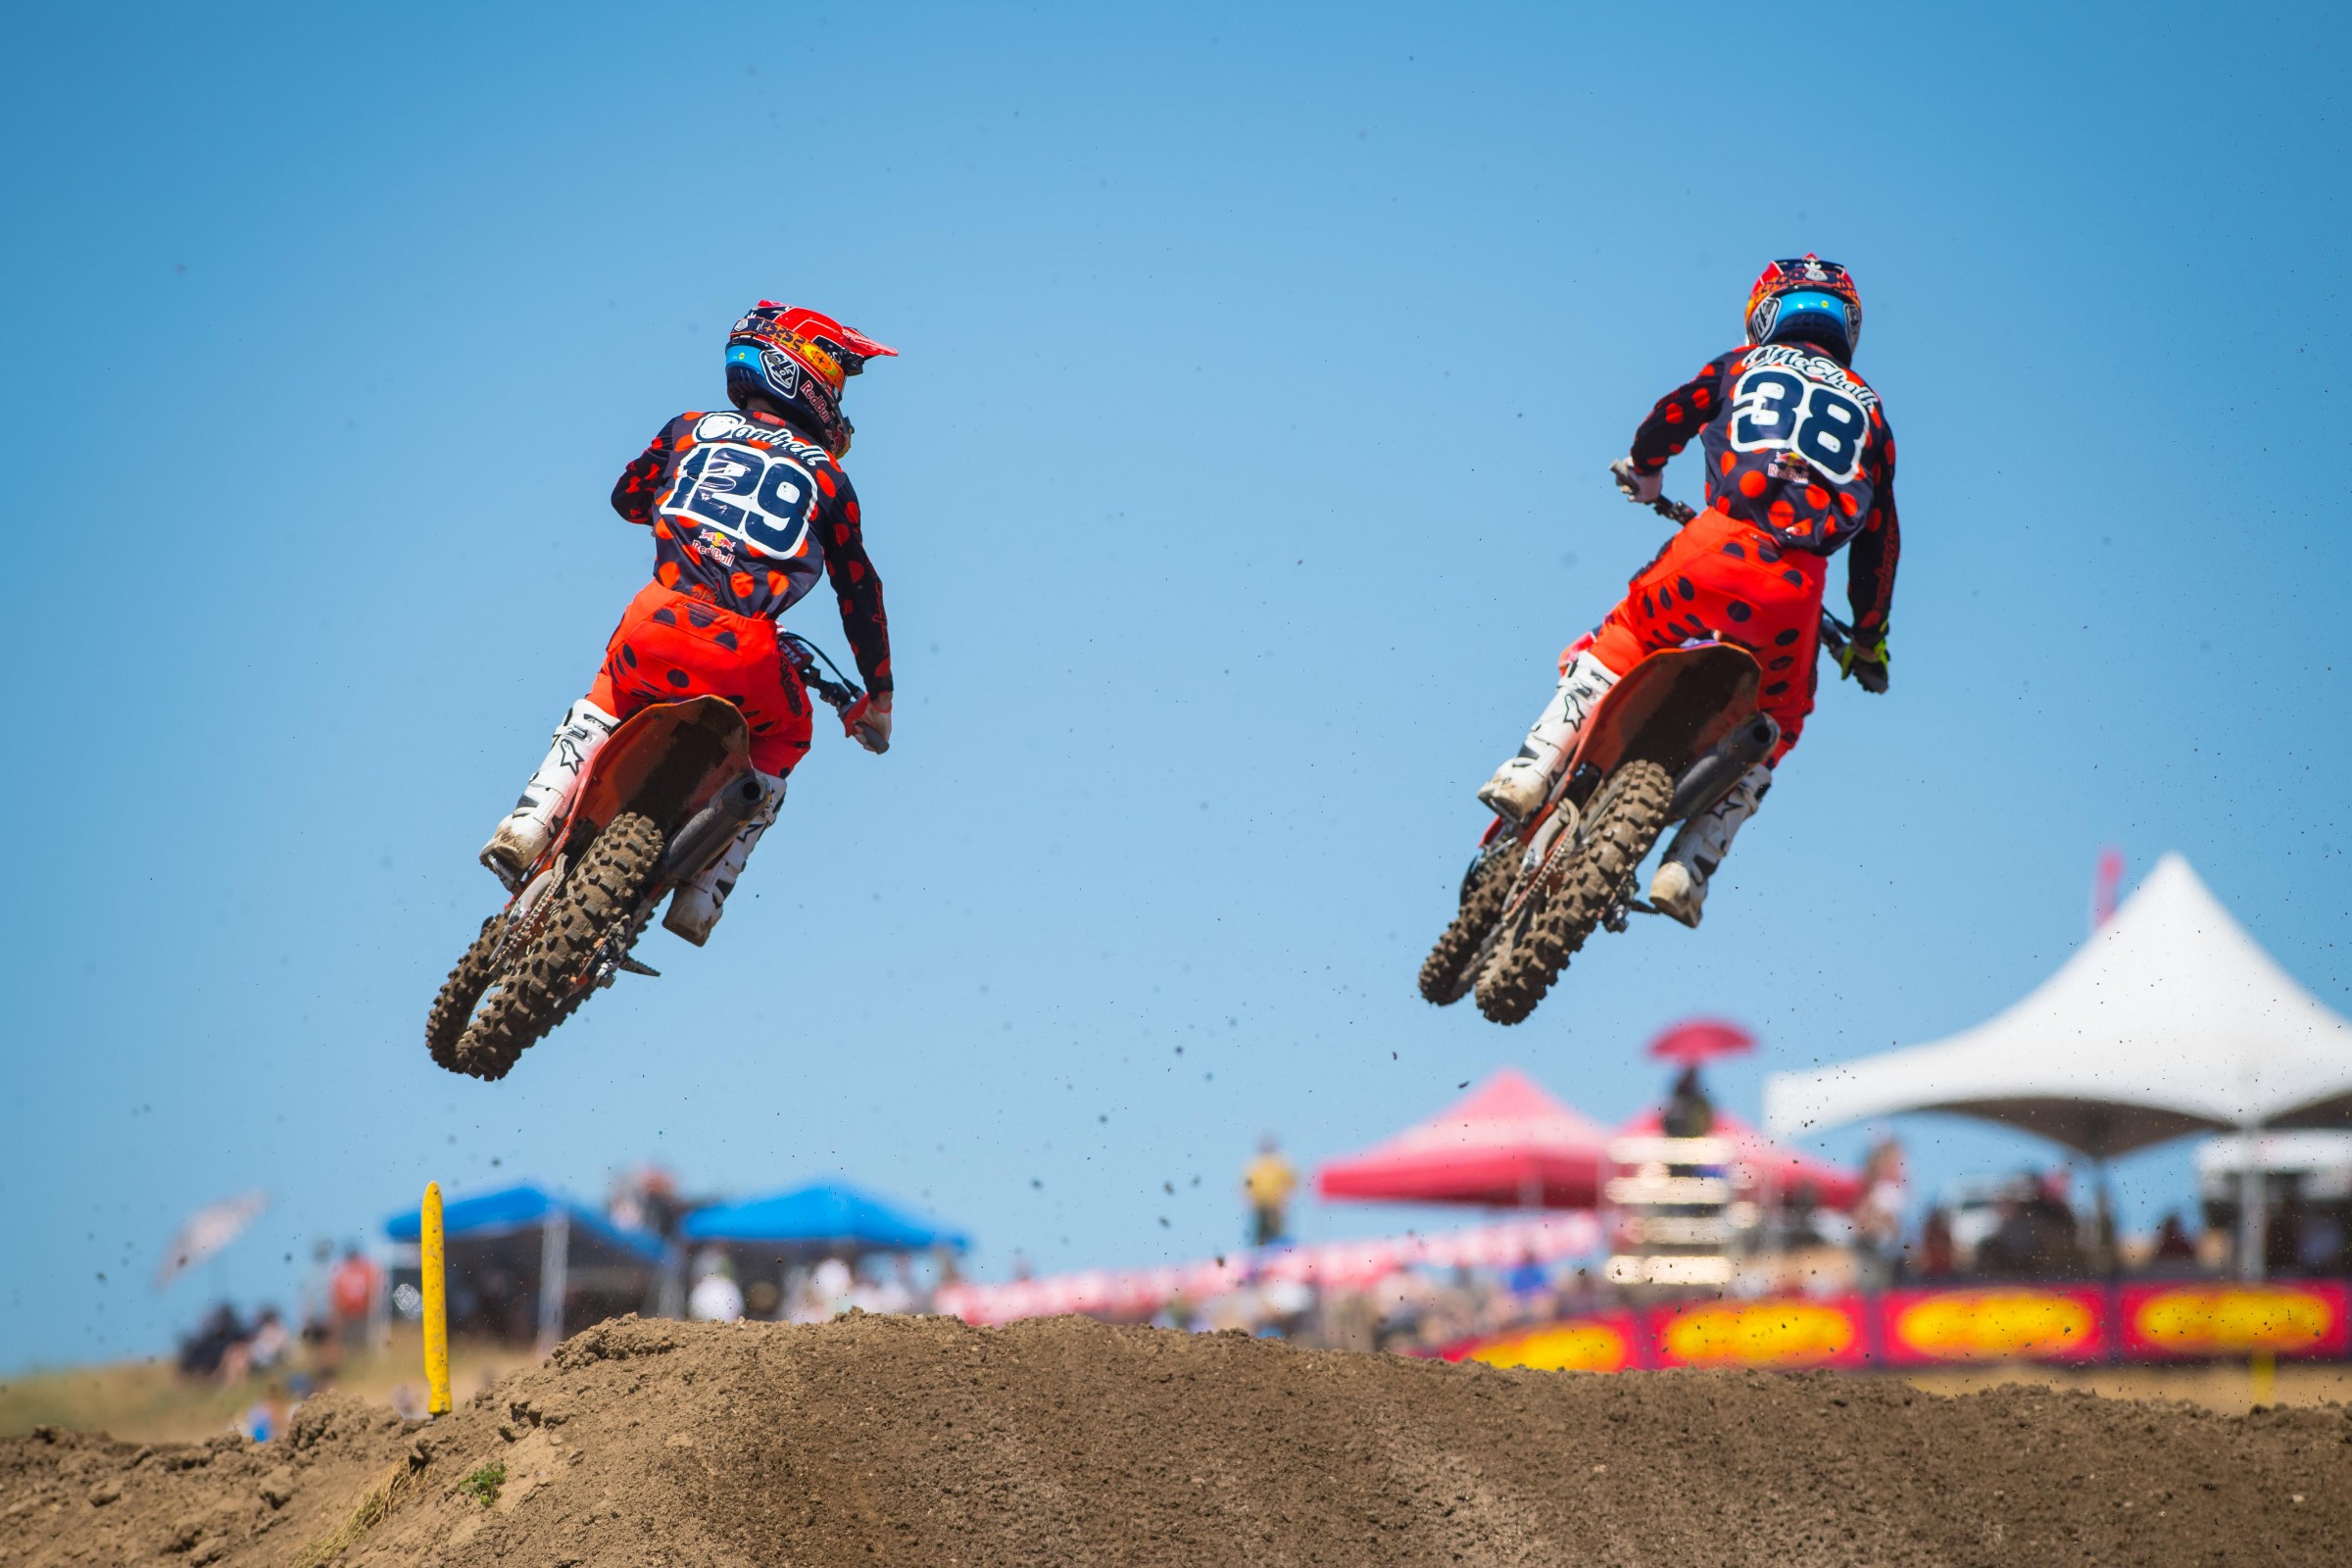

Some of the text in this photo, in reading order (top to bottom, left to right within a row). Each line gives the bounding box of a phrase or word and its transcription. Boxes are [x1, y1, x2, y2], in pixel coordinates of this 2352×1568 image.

[692, 413, 830, 466] Cantrell
[1732, 367, 1868, 483] 38
[661, 443, 817, 559] 129
